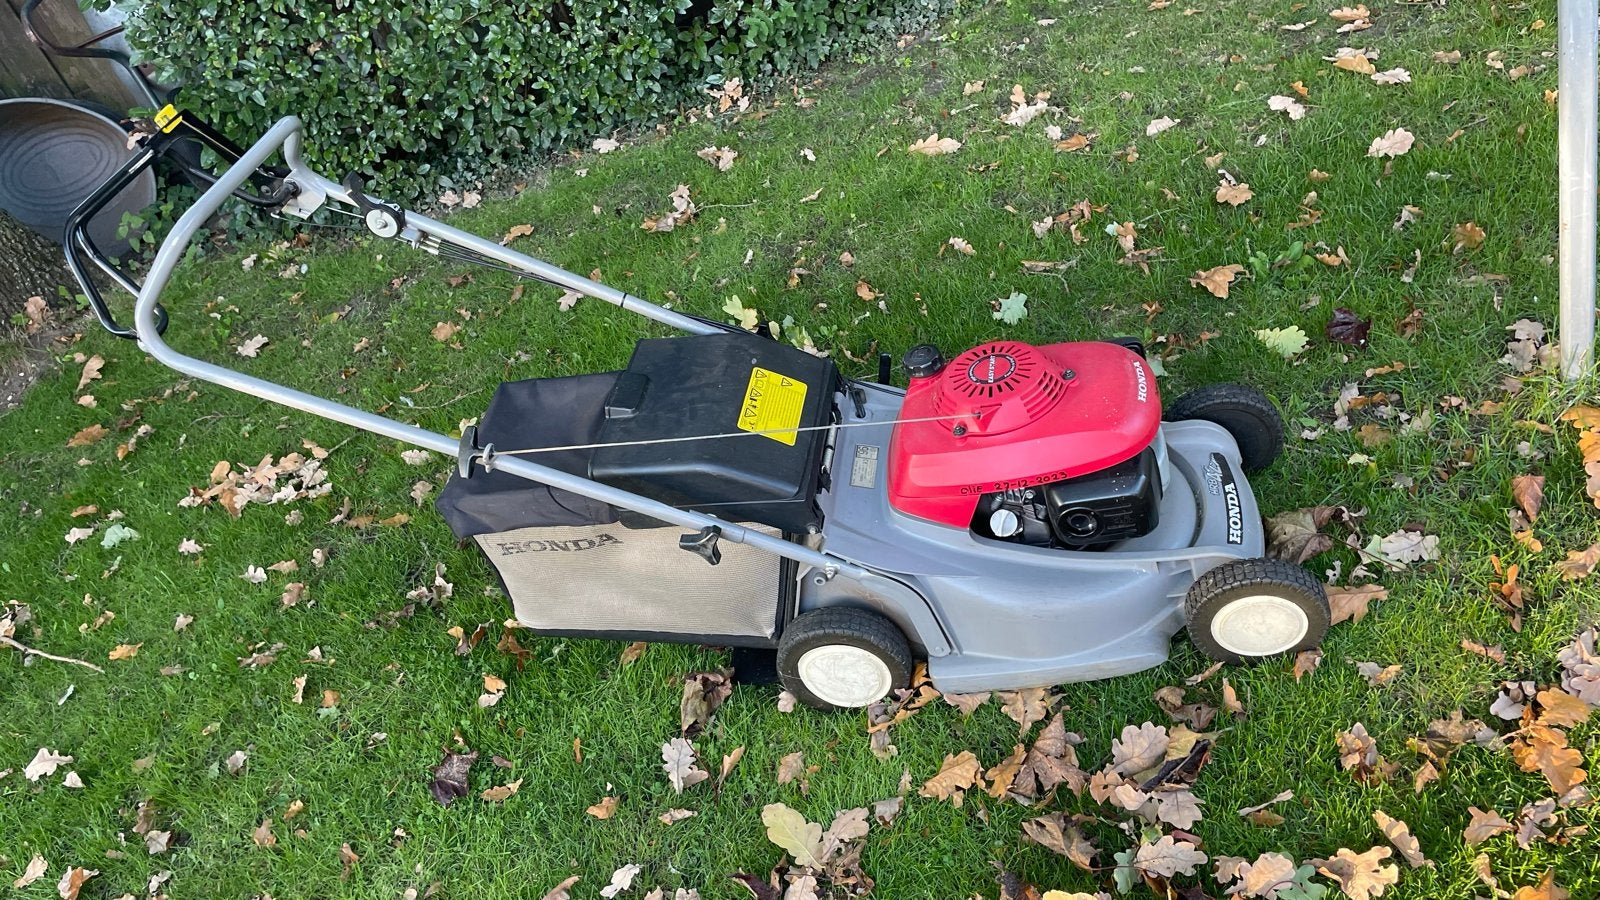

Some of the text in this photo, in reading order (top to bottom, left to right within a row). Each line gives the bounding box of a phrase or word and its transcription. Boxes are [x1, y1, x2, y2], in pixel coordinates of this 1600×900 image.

[1133, 361, 1147, 403] HONDA
[1224, 482, 1241, 544] HONDA
[497, 533, 622, 556] HONDA
